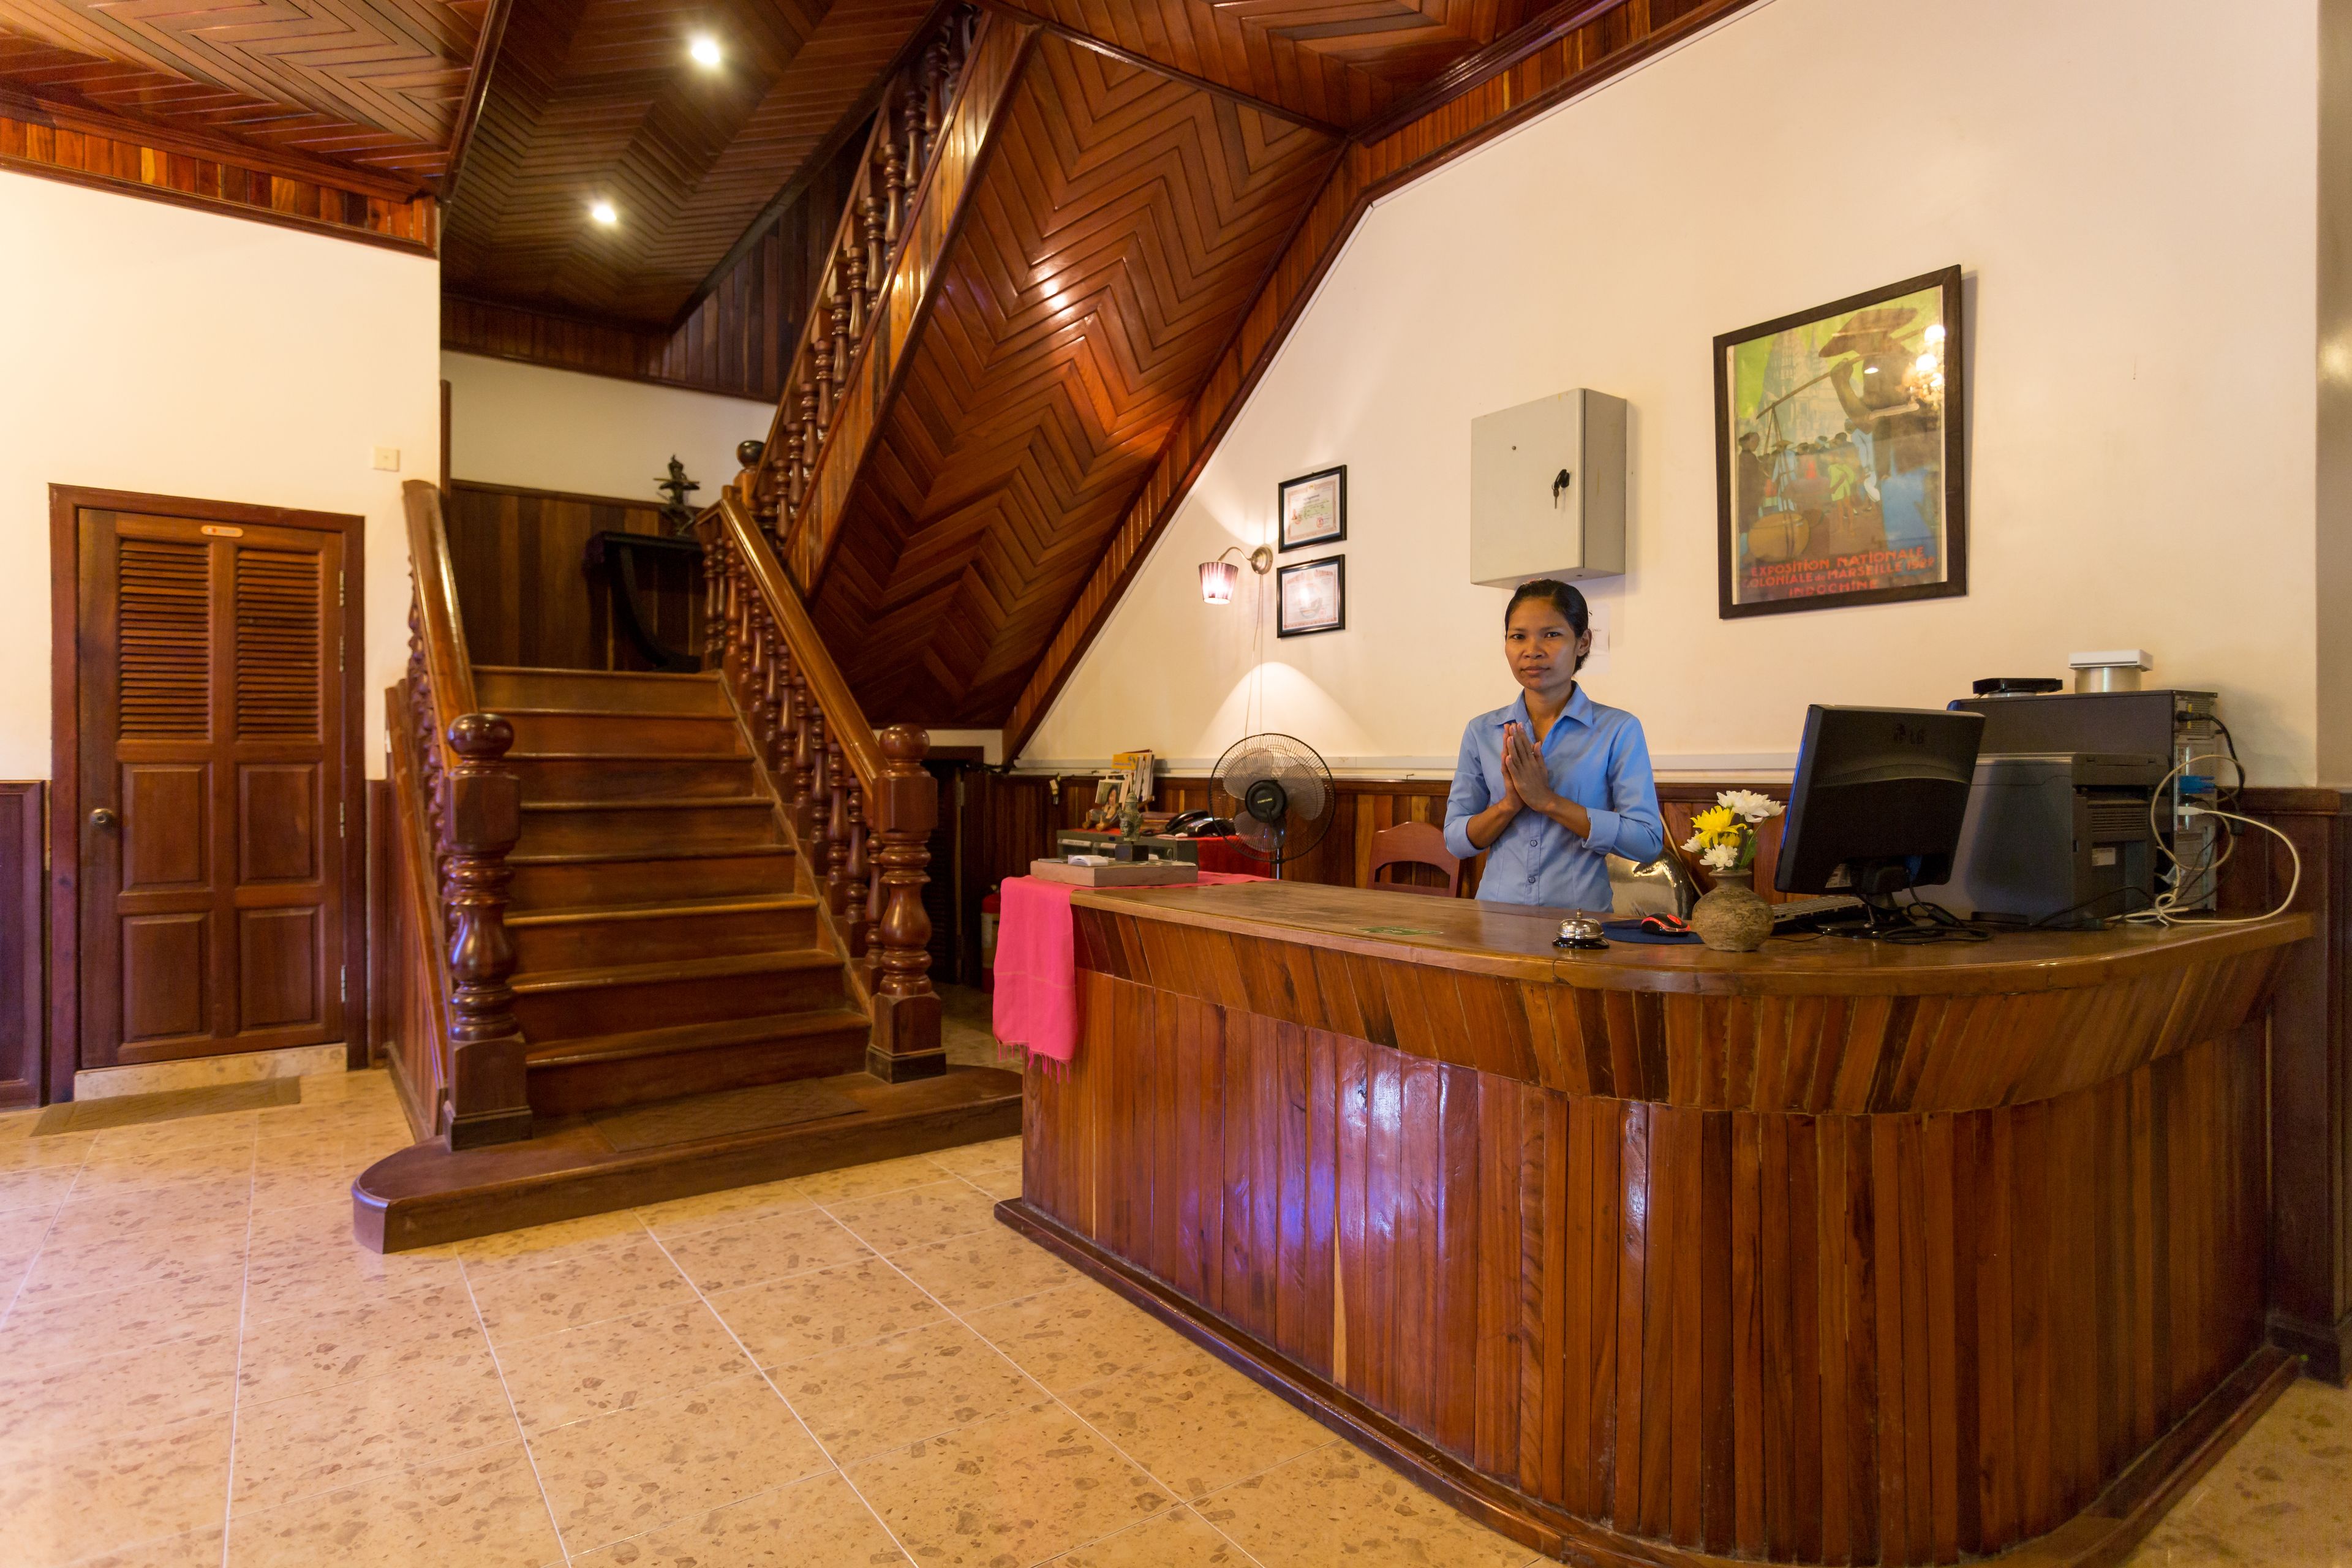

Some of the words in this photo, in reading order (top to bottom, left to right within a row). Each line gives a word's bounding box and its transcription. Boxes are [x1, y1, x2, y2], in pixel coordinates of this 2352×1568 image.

[1751, 558, 1830, 577] EXPOSITION
[1836, 545, 1924, 567] NATIONALE
[1827, 561, 1903, 580] MARSEILLE
[1789, 579, 1878, 598] INDOCHINE
[1910, 729, 1924, 745] LG
